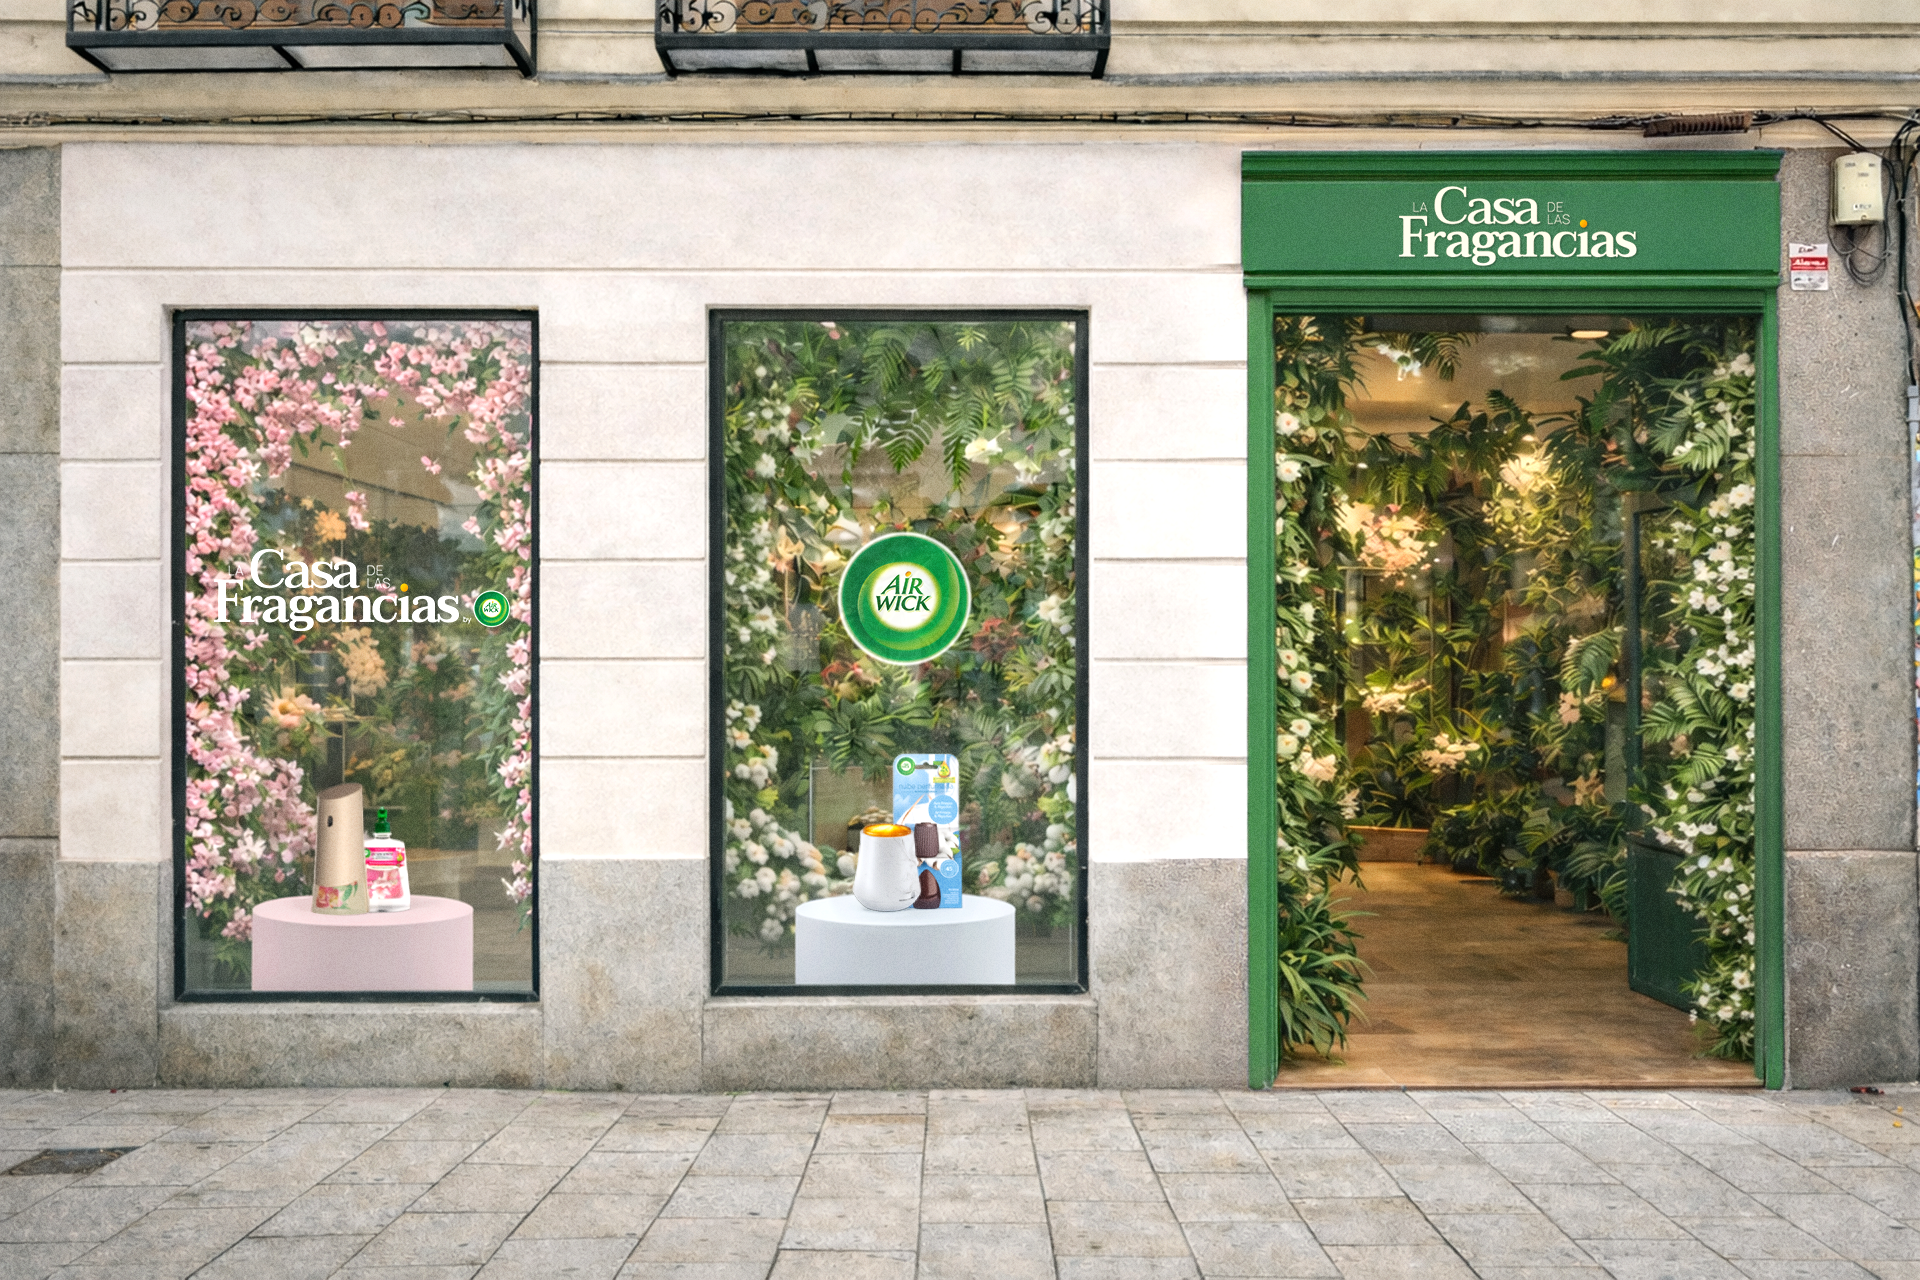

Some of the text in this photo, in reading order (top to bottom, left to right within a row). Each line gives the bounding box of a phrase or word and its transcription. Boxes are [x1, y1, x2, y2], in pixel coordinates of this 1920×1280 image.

[1412, 186, 1564, 225] LA Casa DE
[1547, 213, 1571, 225] LAS
[1398, 215, 1638, 267] Fragancias
[228, 548, 384, 589] LA Casa DE
[366, 577, 391, 589] LAS
[213, 578, 460, 632] Fragancias
[875, 595, 931, 612] WICK
[462, 616, 472, 625] by
